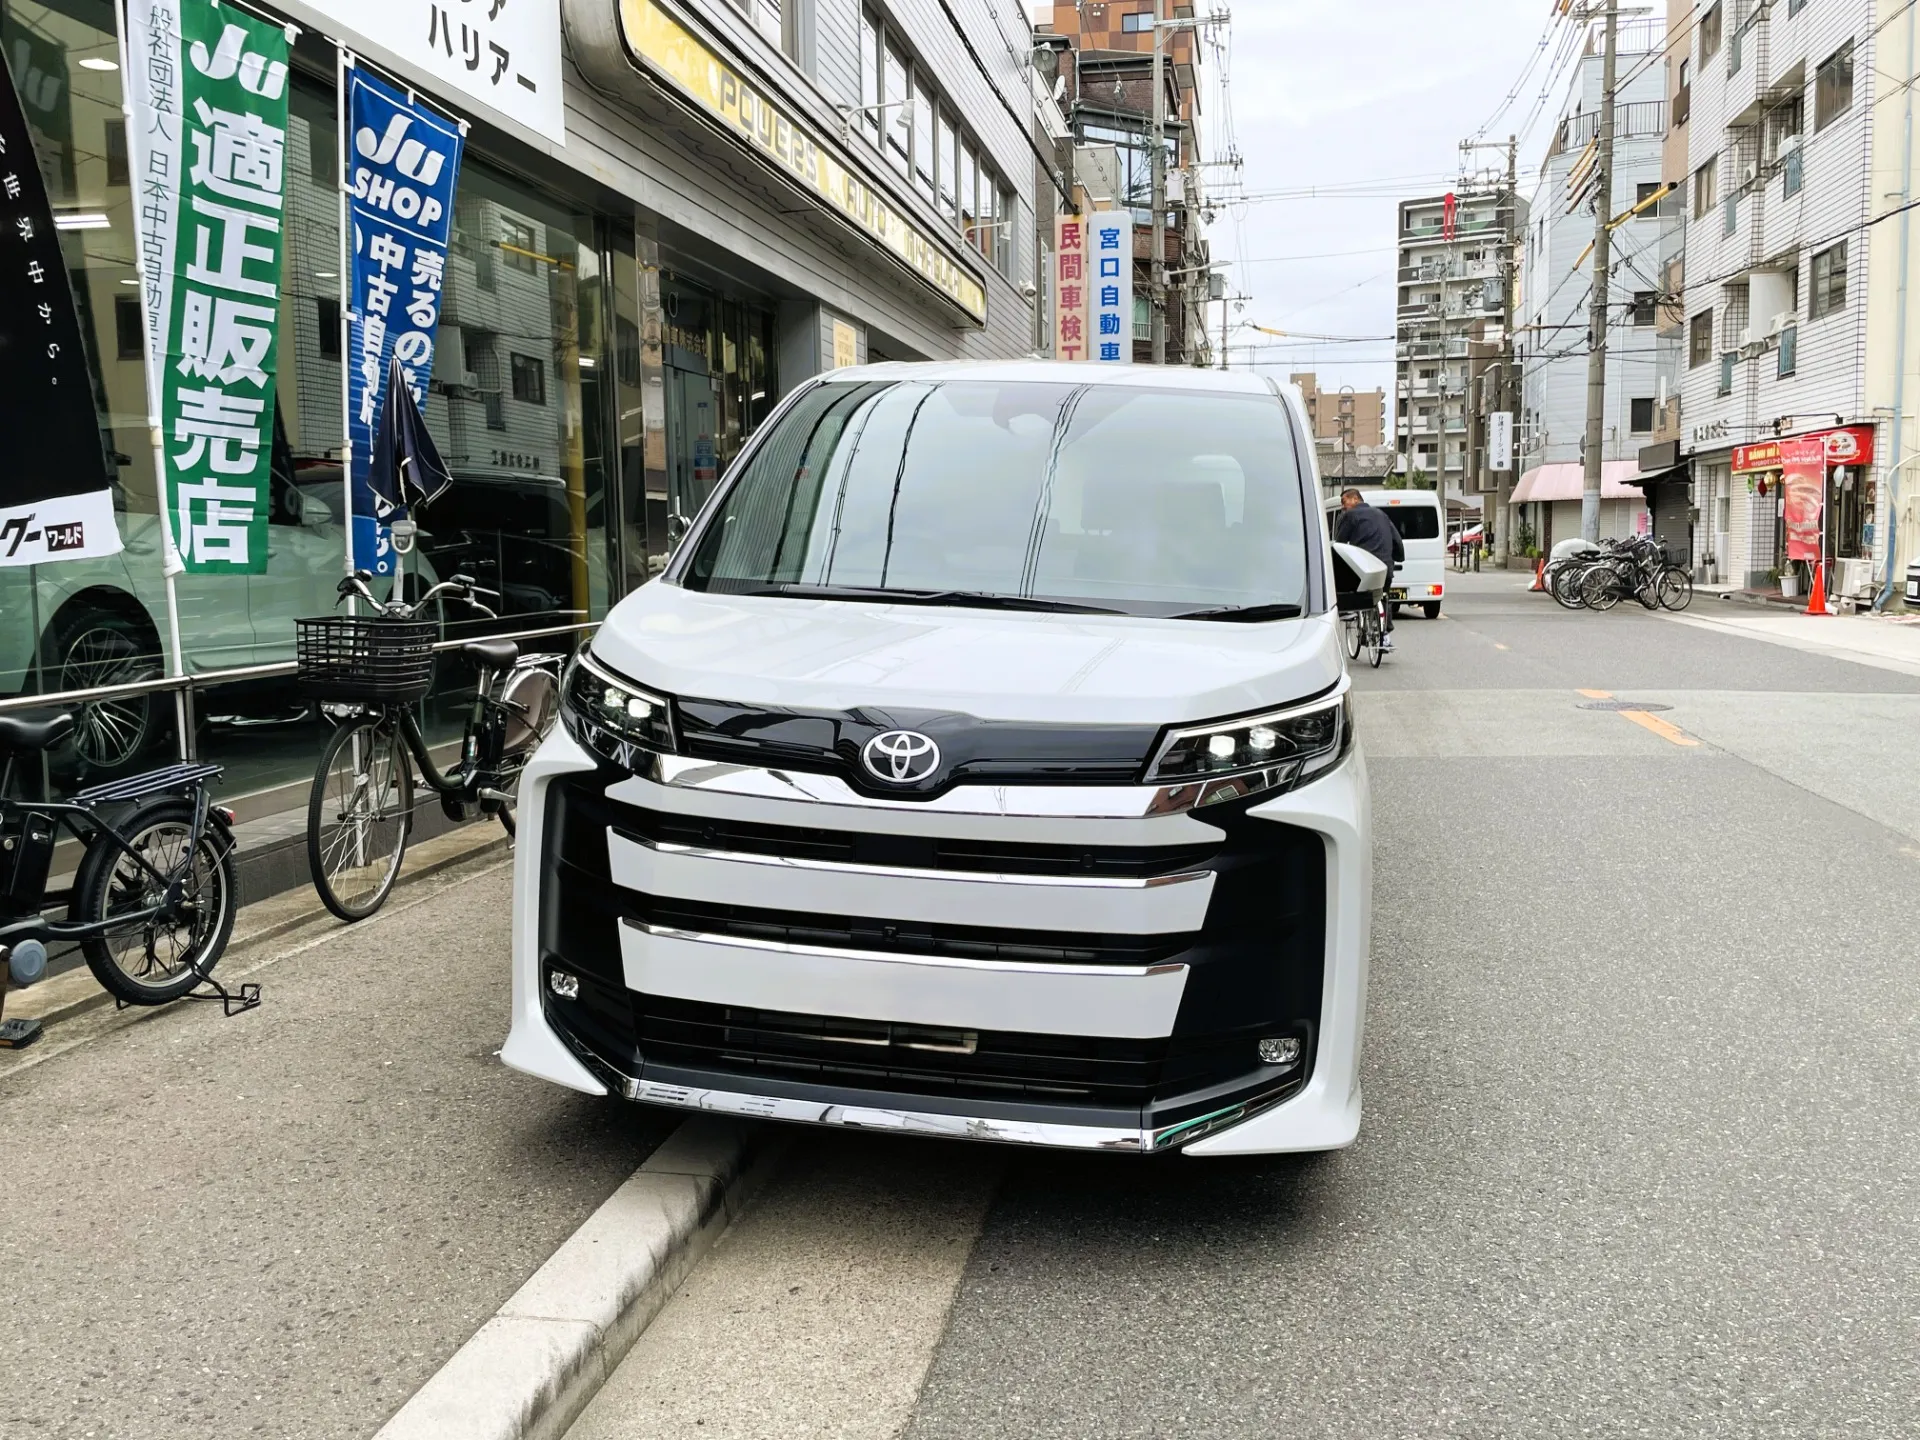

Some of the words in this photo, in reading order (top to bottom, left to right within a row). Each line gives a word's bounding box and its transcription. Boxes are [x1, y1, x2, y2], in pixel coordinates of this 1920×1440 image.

[428, 4, 537, 93] ハリアー
[354, 167, 443, 228] SHOP
[846, 175, 887, 238] AUTO
[171, 95, 286, 564] 適正販売店
[1099, 227, 1121, 361] 宮口自動車
[47, 526, 82, 547] ワールド
